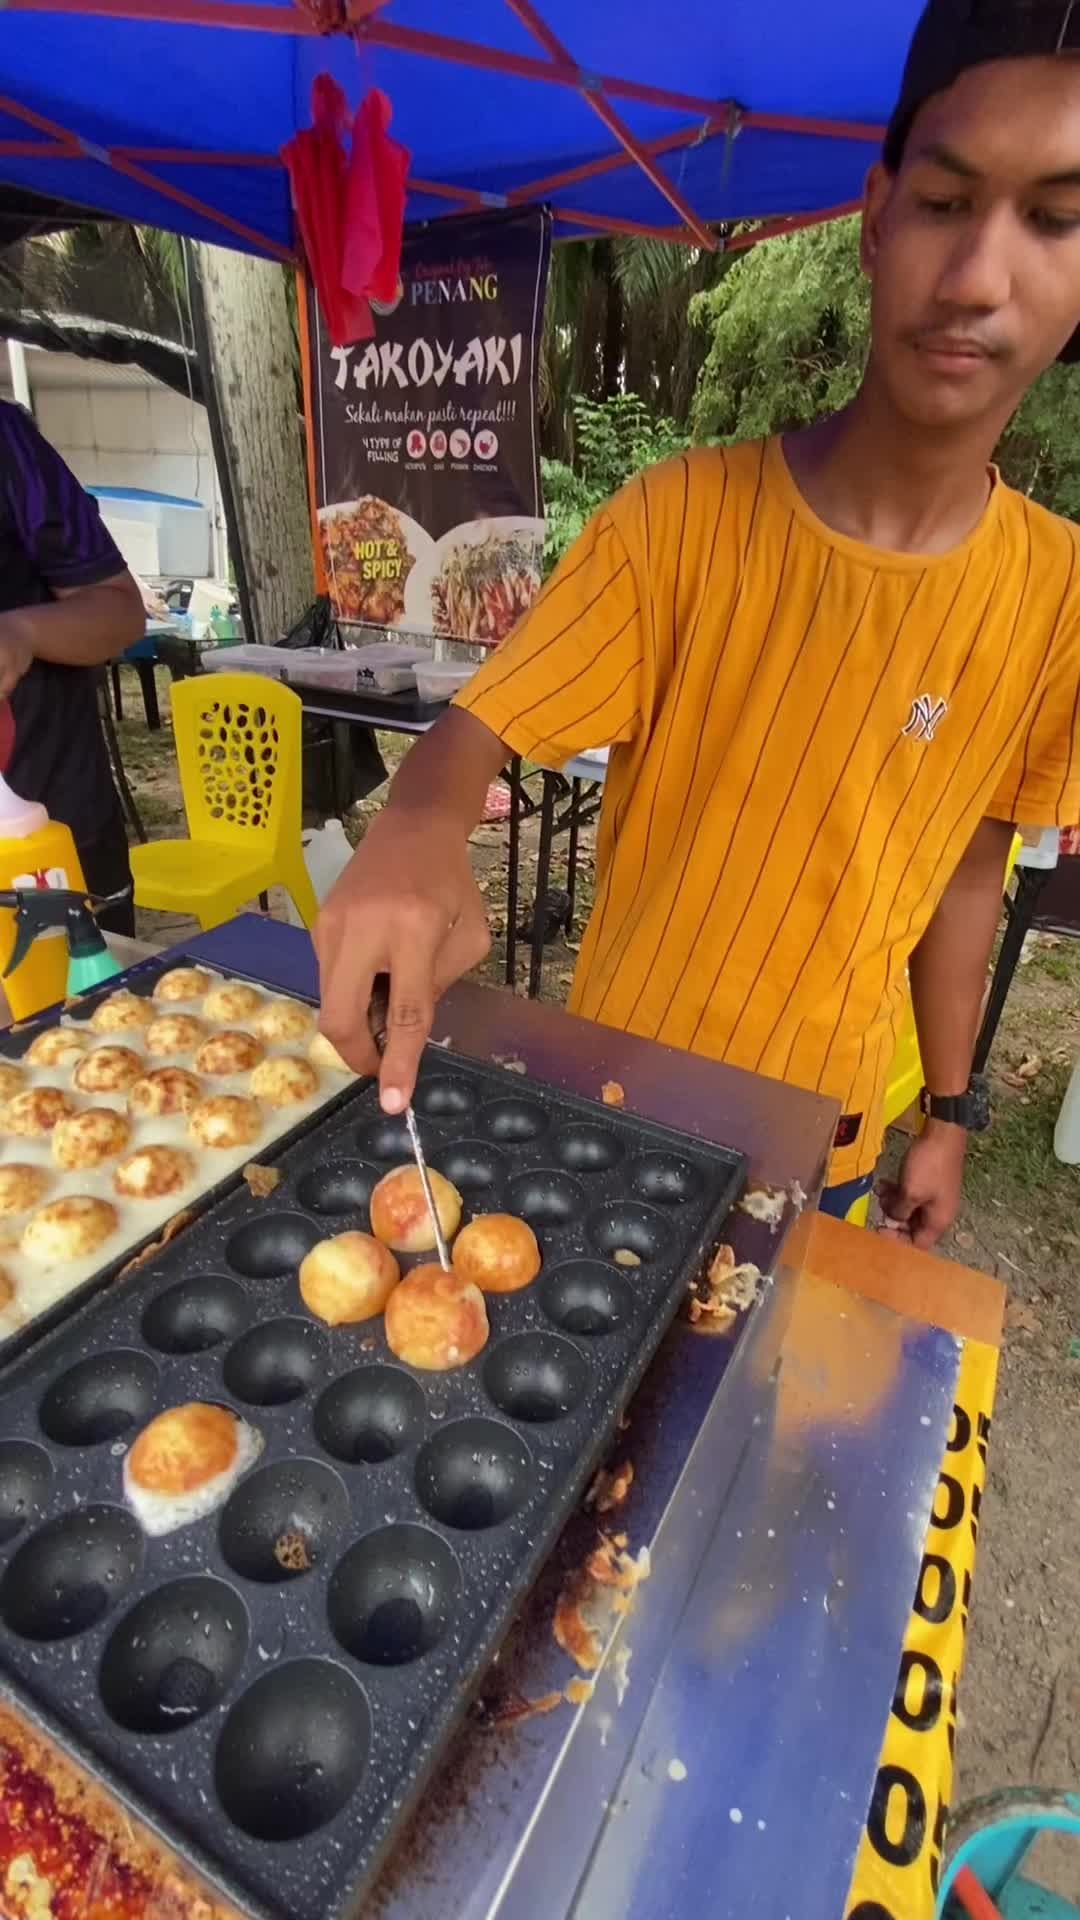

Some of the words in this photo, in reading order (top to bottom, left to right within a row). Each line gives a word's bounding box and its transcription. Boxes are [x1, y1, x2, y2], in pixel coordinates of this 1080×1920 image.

[411, 272, 498, 307] PENANG
[330, 332, 523, 391] TAKOYAKI
[344, 401, 383, 424] Sekali
[384, 400, 427, 424] makan
[427, 400, 458, 432] pasti
[367, 450, 399, 464] FILLING
[354, 540, 384, 560] HOT
[386, 538, 399, 557] &
[362, 558, 402, 579] SPICY
[902, 693, 948, 741] NY
